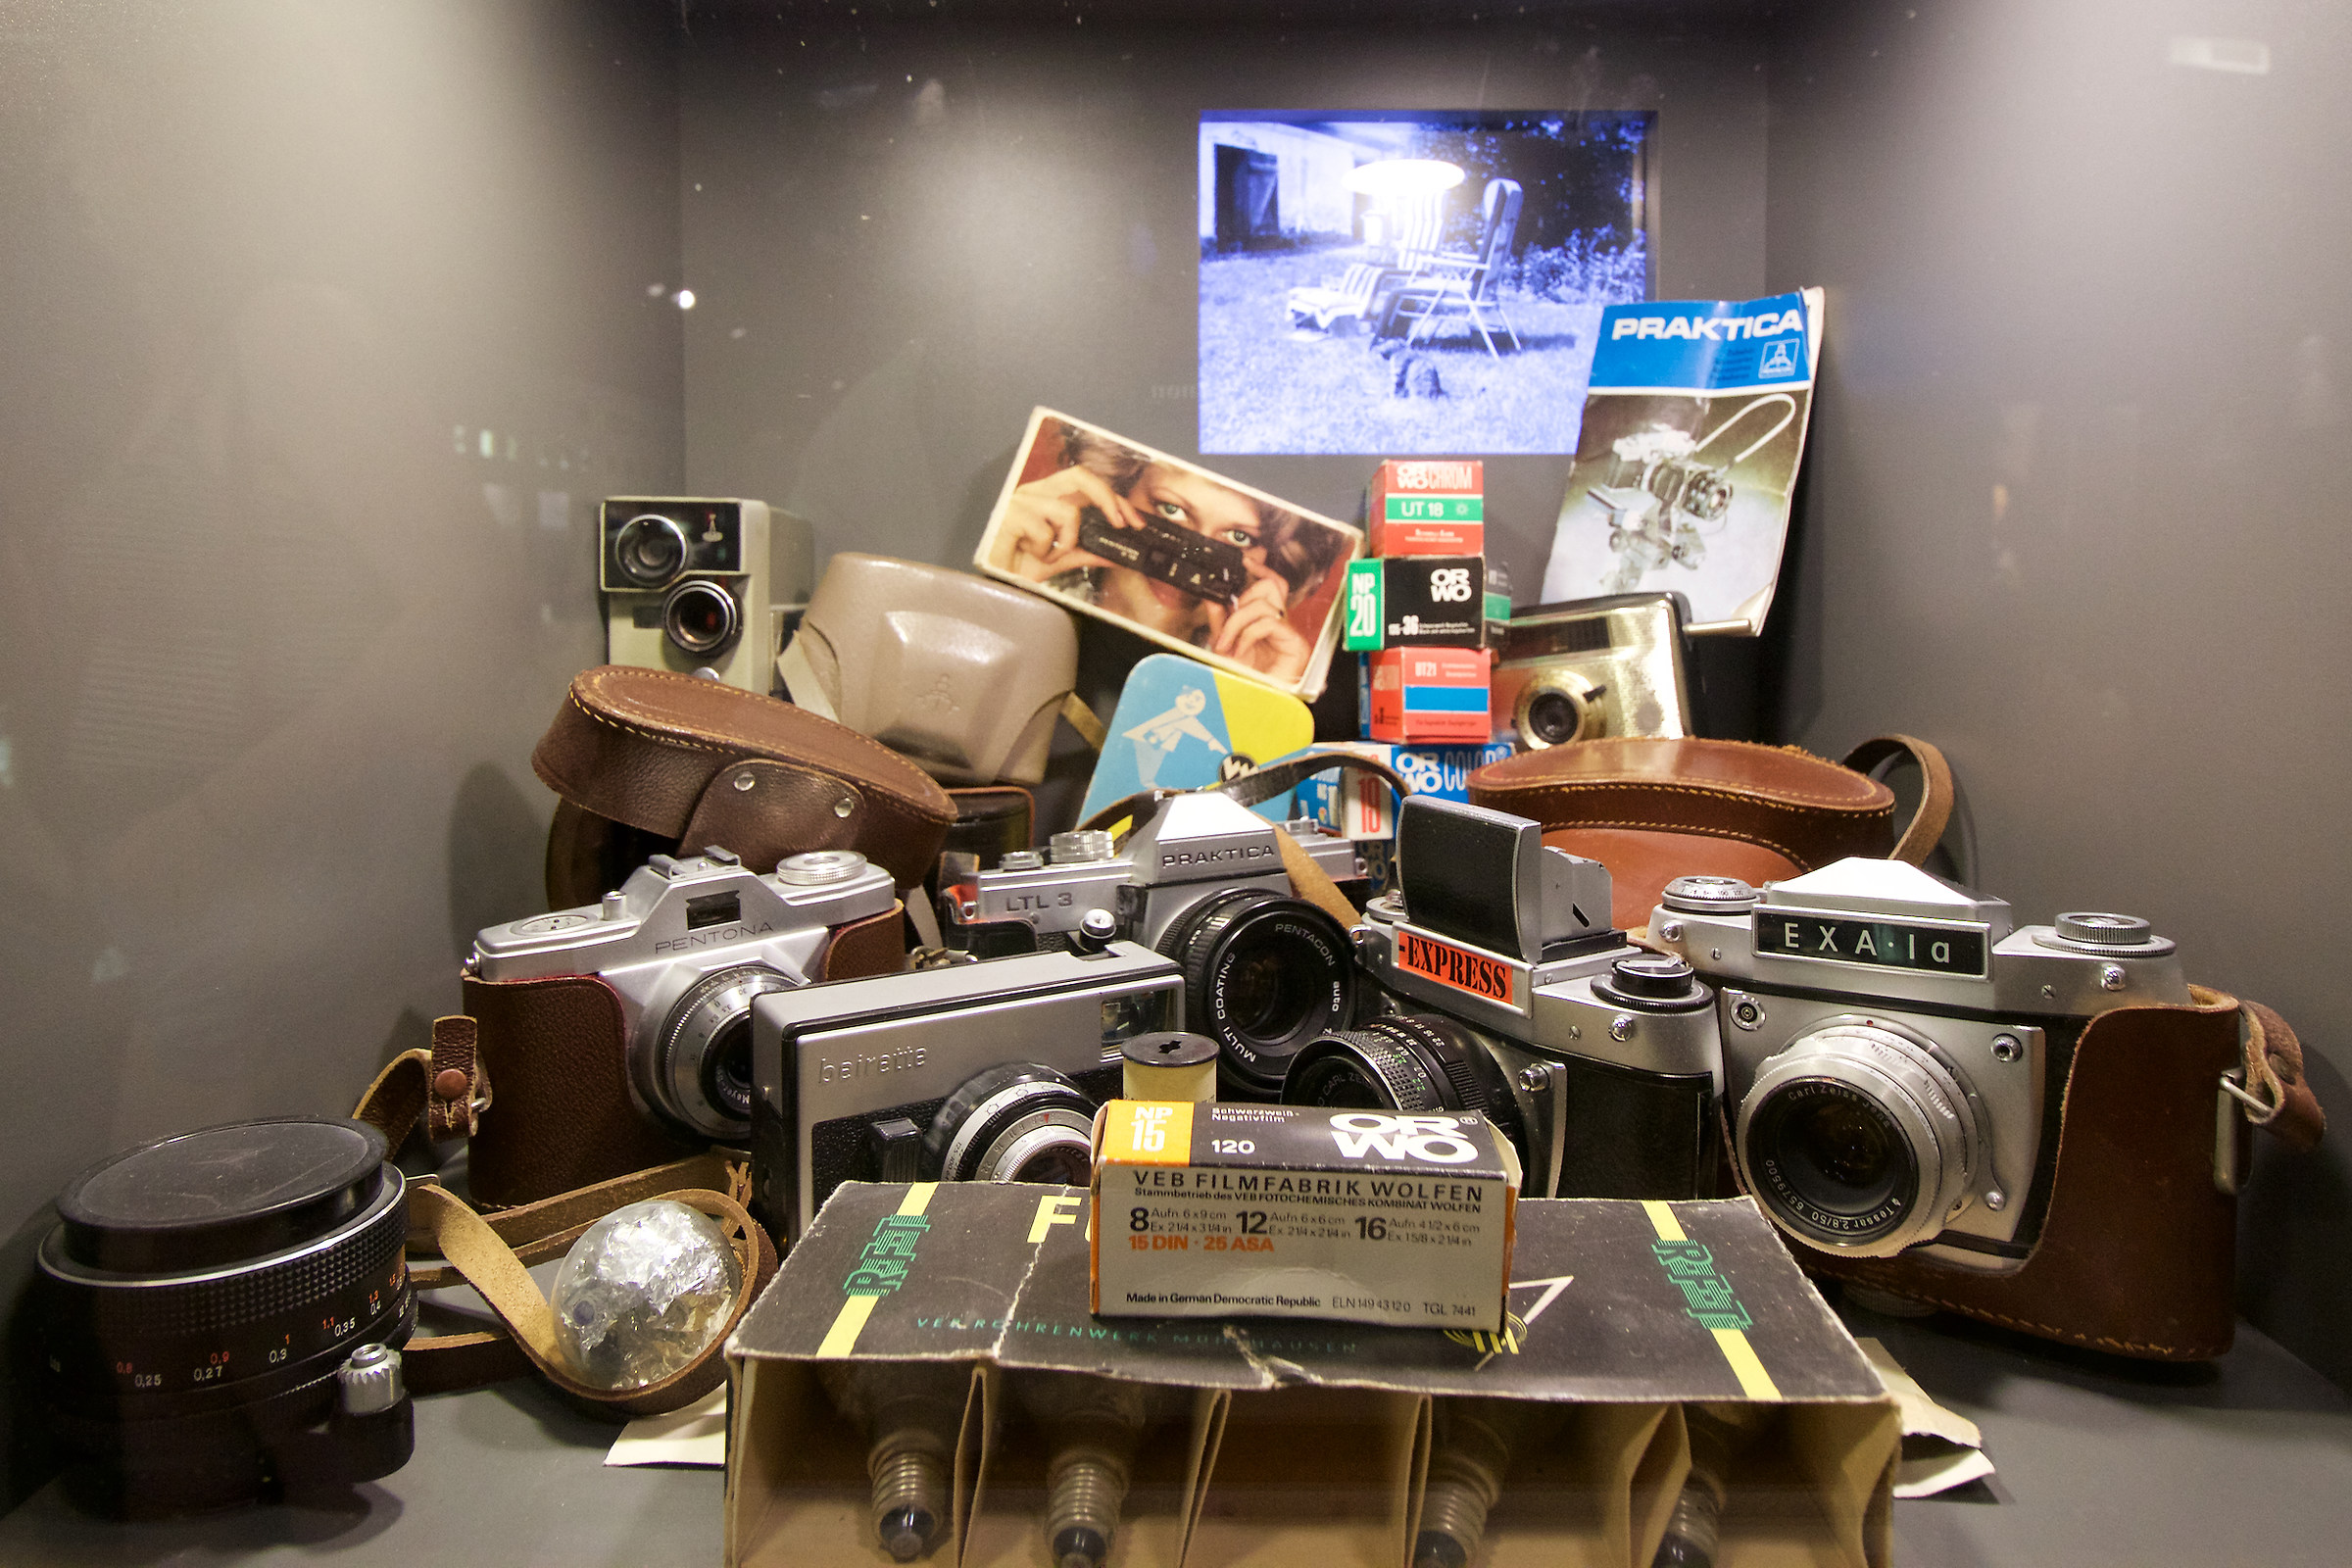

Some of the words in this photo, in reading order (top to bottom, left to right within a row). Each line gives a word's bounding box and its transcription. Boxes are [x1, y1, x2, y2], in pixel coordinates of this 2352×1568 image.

[1611, 309, 1803, 341] PRAKTICA
[1400, 501, 1425, 517] UT
[1427, 502, 1445, 517] 18
[1351, 572, 1376, 595] NP
[1349, 593, 1377, 637] 20
[1162, 845, 1275, 868] PRAKTICA
[1005, 895, 1050, 912] LTL
[1057, 892, 1073, 907] 3
[656, 922, 774, 955] PENTONA
[1274, 923, 1336, 967] PENTACON
[1331, 981, 1342, 1012] auto
[1215, 952, 1237, 1020] COATING
[1222, 1025, 1257, 1063] MULTI
[817, 1046, 927, 1084] bairette
[1788, 1085, 1816, 1102] Carl
[1134, 1106, 1173, 1120] NP
[1211, 1114, 1286, 1123] Negativfilm
[1131, 1119, 1167, 1152] 15
[1211, 1139, 1256, 1154] 120
[1133, 1171, 1185, 1188] VEB
[1196, 1173, 1360, 1197] FILMFABRIK
[1371, 1181, 1483, 1203] WOLFEN
[1135, 1187, 1212, 1200] Stammbetrieb
[1214, 1190, 1233, 1200] des
[1234, 1192, 1257, 1201] VEB
[1258, 1193, 1366, 1207] FOTOCHEMISCHES
[1367, 1200, 1427, 1210] KOMBINAT
[1430, 1201, 1481, 1213] WOLFEN
[1130, 1206, 1150, 1232] 8
[1236, 1210, 1267, 1235] 12
[1355, 1215, 1387, 1241] 16
[1810, 1210, 1849, 1231] 2.8/50
[1129, 1235, 1150, 1250] 15
[1152, 1235, 1189, 1251] DIN
[1203, 1235, 1228, 1251] 25
[1231, 1236, 1275, 1252] ASA
[1126, 1293, 1156, 1303] Made
[1158, 1293, 1168, 1303] in
[1170, 1293, 1212, 1303] German
[1213, 1293, 1274, 1305] Democratic
[1276, 1295, 1321, 1308] Republic
[1332, 1297, 1355, 1309] ELN
[1423, 1302, 1447, 1316] TGL
